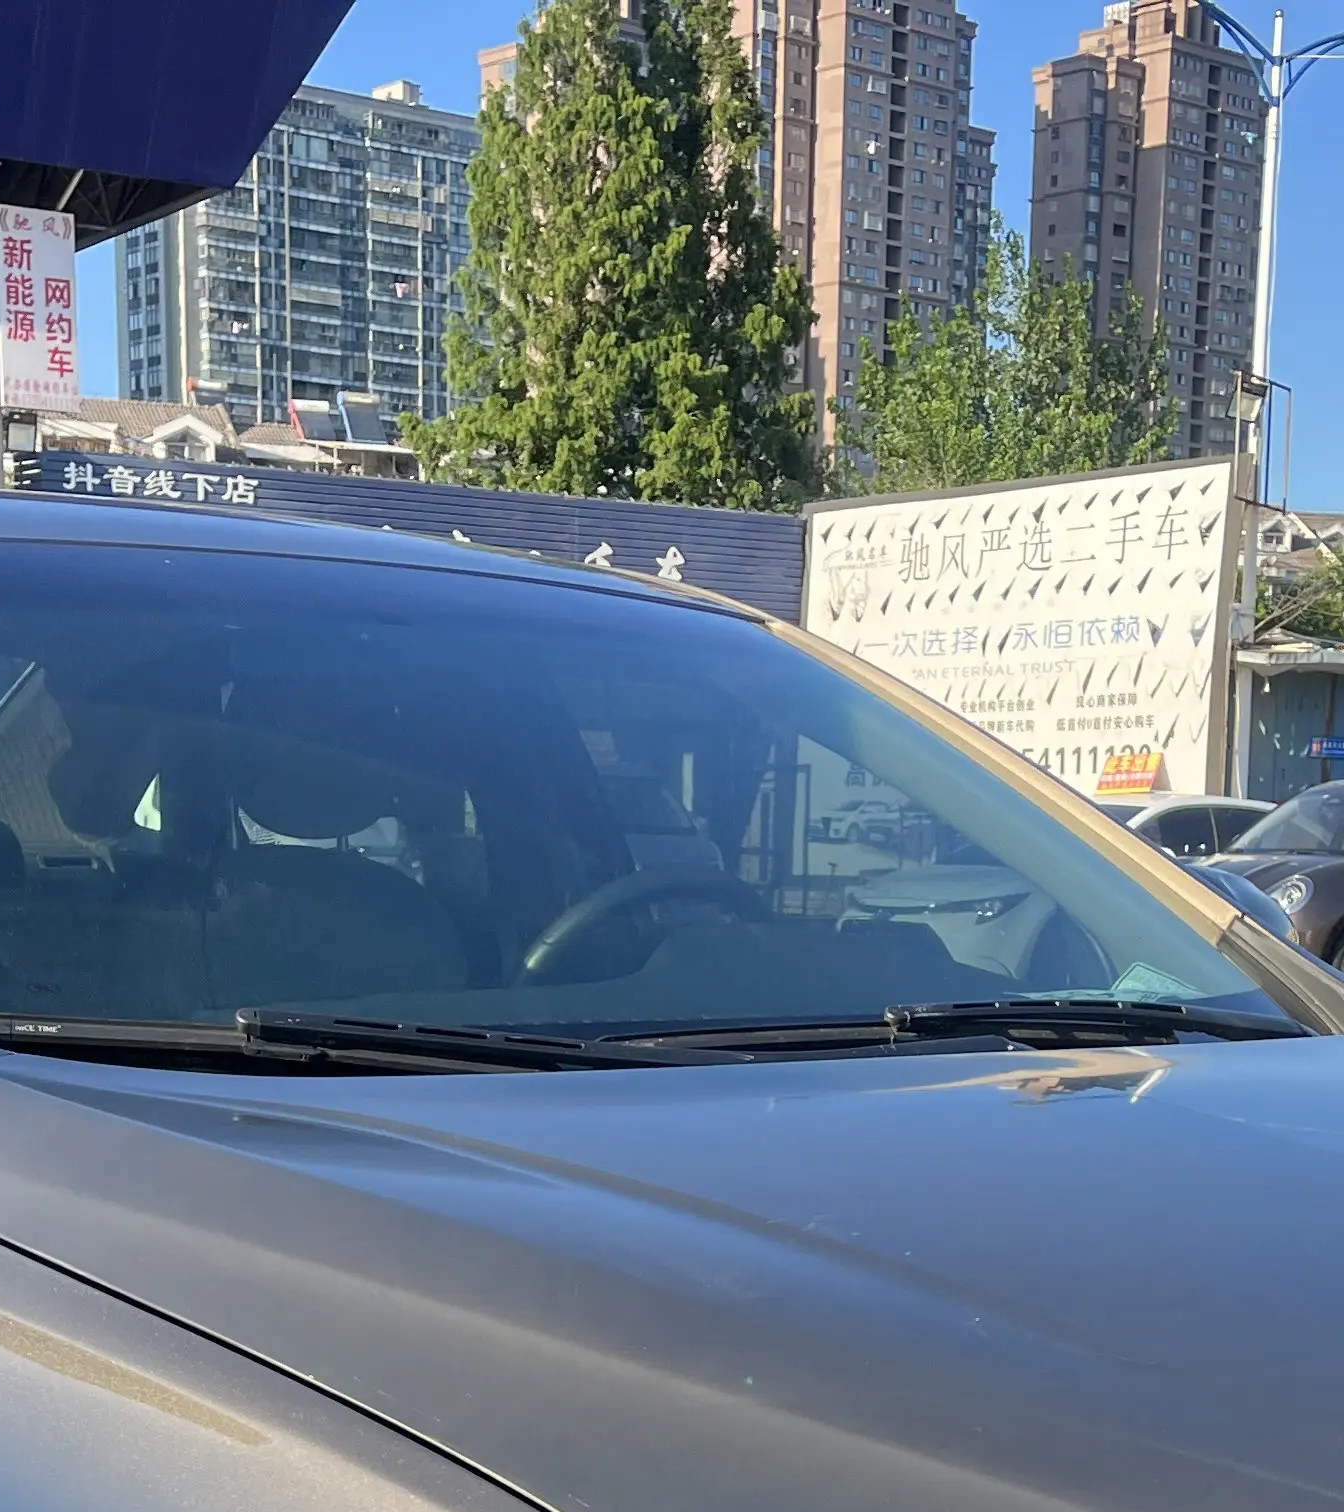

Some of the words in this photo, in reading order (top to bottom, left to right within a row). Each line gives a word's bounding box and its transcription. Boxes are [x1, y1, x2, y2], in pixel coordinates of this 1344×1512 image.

[3, 236, 35, 342] 新能源
[44, 277, 74, 378] 网约车
[62, 461, 259, 505] 抖音线下店
[898, 505, 1189, 584] 驰风严选二手车
[864, 625, 980, 658] 一次选择
[1012, 615, 1141, 651] 永恒依赖
[941, 663, 1014, 678] ETERNAL
[1020, 660, 1076, 676] TRUST
